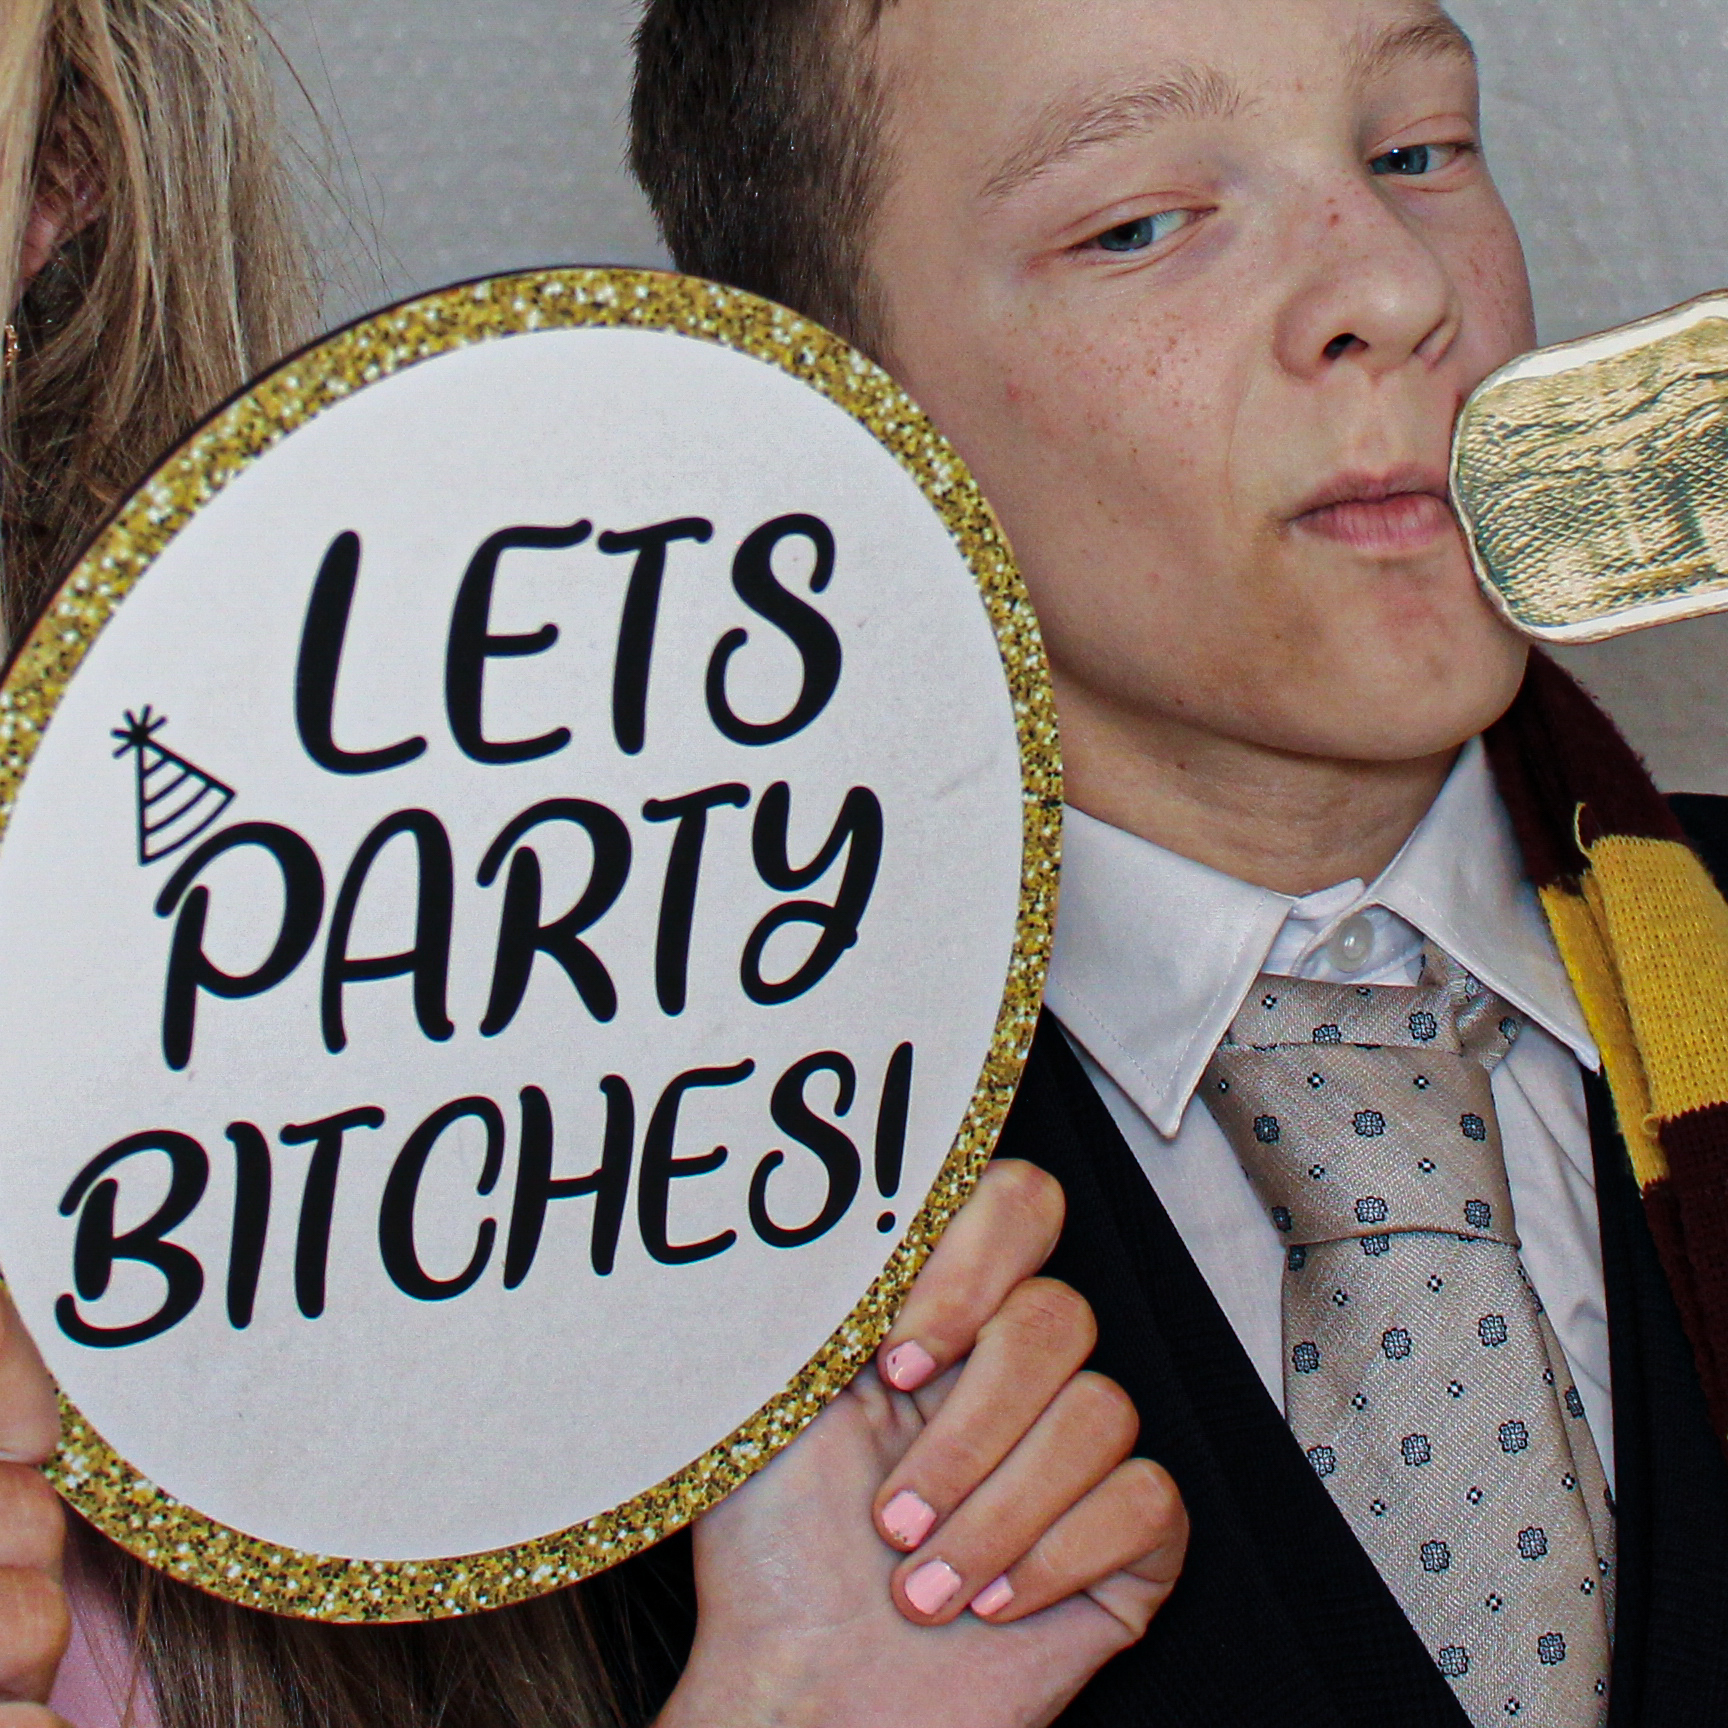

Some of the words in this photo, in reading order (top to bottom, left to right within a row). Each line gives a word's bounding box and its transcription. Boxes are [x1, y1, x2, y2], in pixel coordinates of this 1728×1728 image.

[294, 514, 844, 774] LETS
[155, 781, 883, 1071] PARTY
[54, 1042, 914, 1349] BITCHES!
